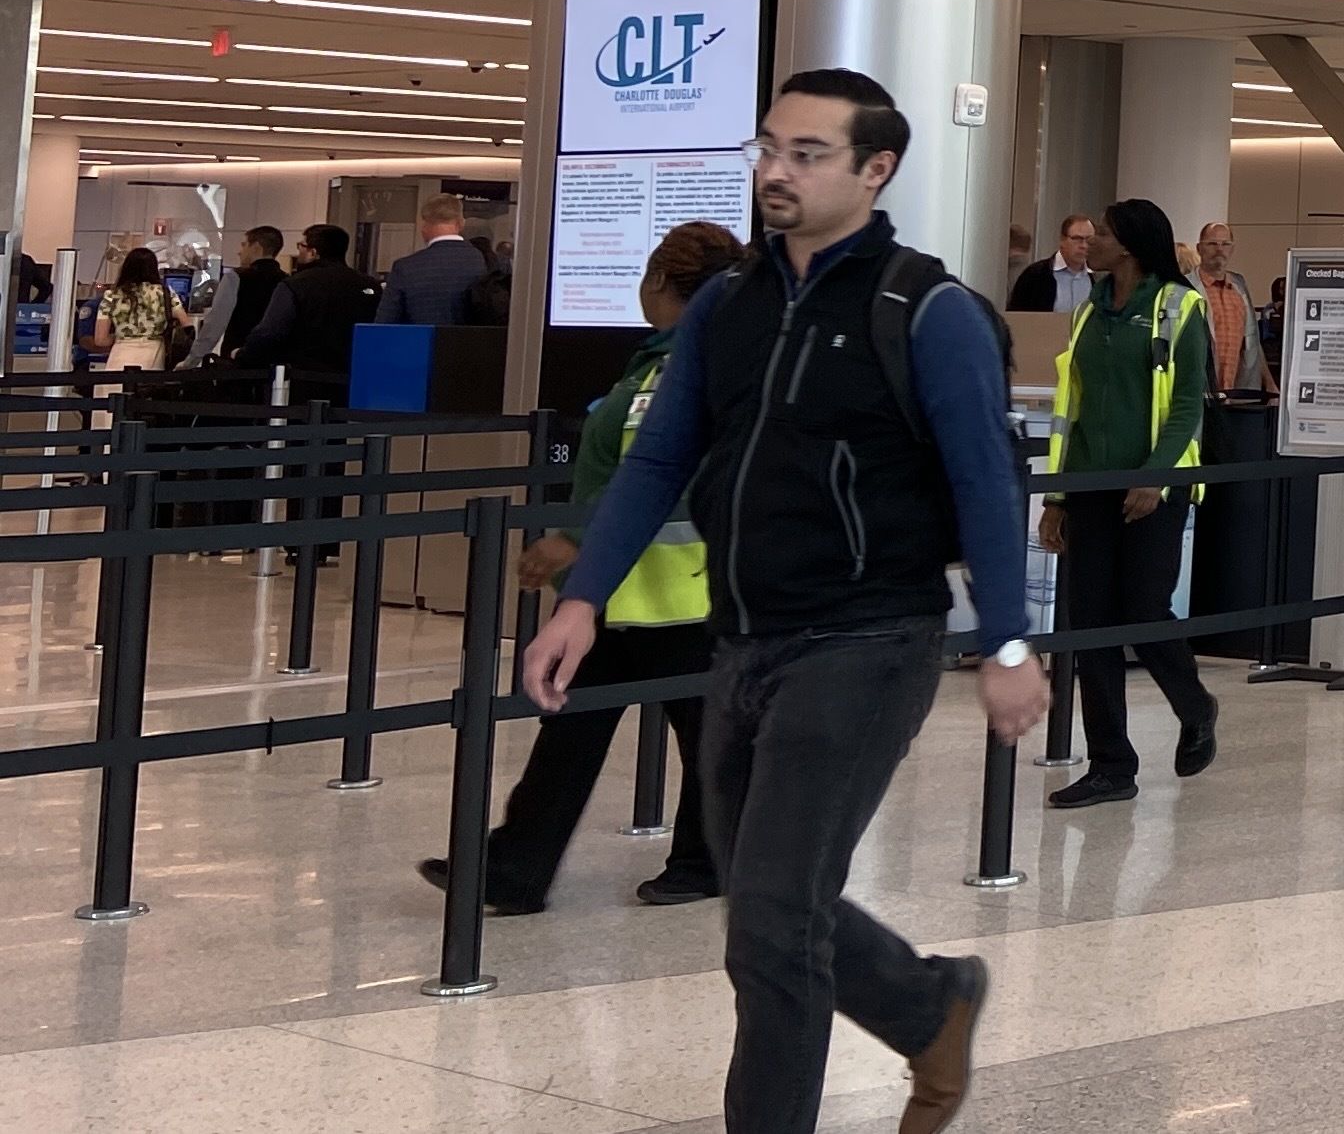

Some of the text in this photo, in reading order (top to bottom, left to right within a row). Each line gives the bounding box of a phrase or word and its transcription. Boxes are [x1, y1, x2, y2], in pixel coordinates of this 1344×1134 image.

[617, 13, 704, 85] CLT
[614, 87, 702, 102] CHARLOTTE DOUGLAS
[1305, 269, 1331, 278] Checked
